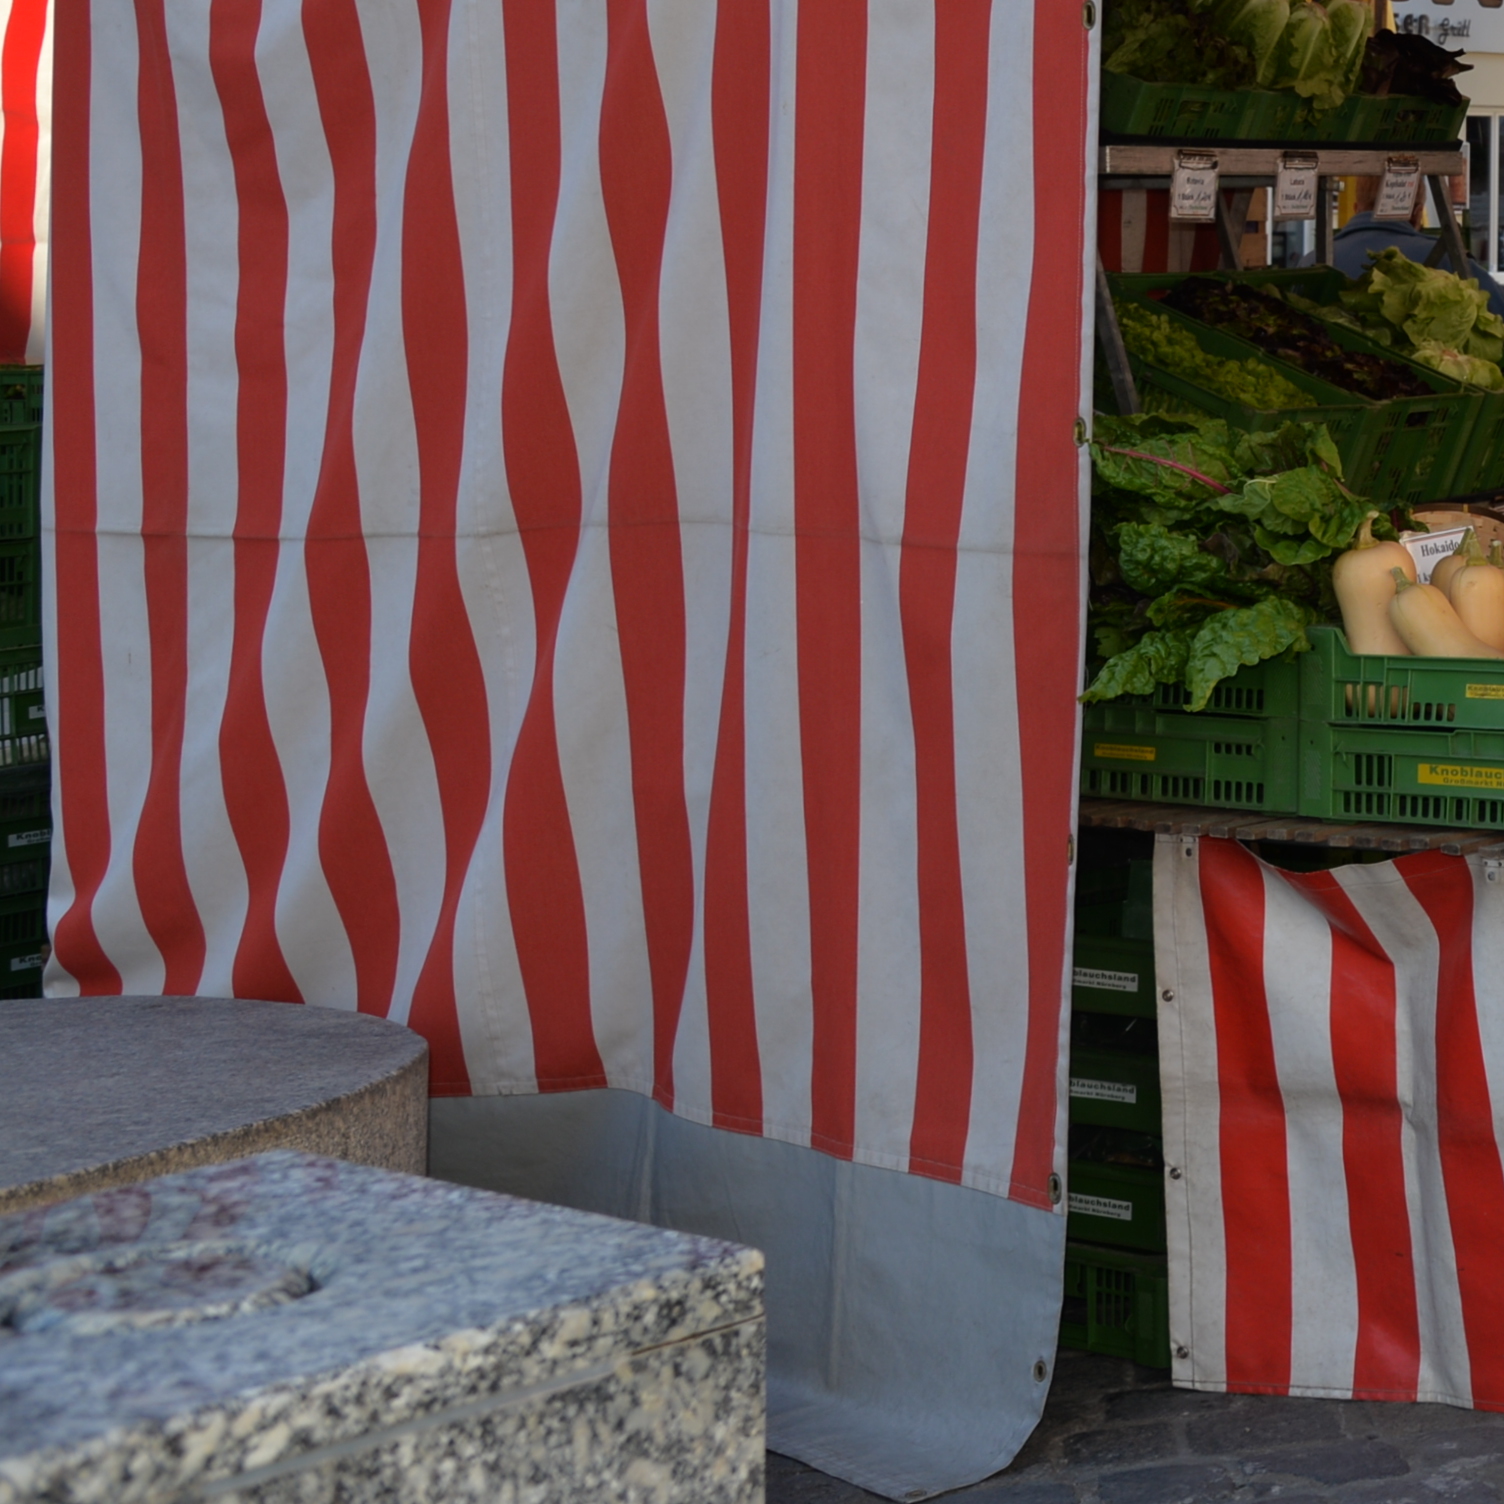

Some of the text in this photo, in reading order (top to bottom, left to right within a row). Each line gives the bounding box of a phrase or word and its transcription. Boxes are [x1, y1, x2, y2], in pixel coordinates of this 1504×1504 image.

[1443, 777, 1494, 787] Großmarkt
[1073, 970, 1136, 983] blauchsland
[1070, 1080, 1134, 1094] blauchsland
[1069, 1195, 1130, 1211] blauchsland
